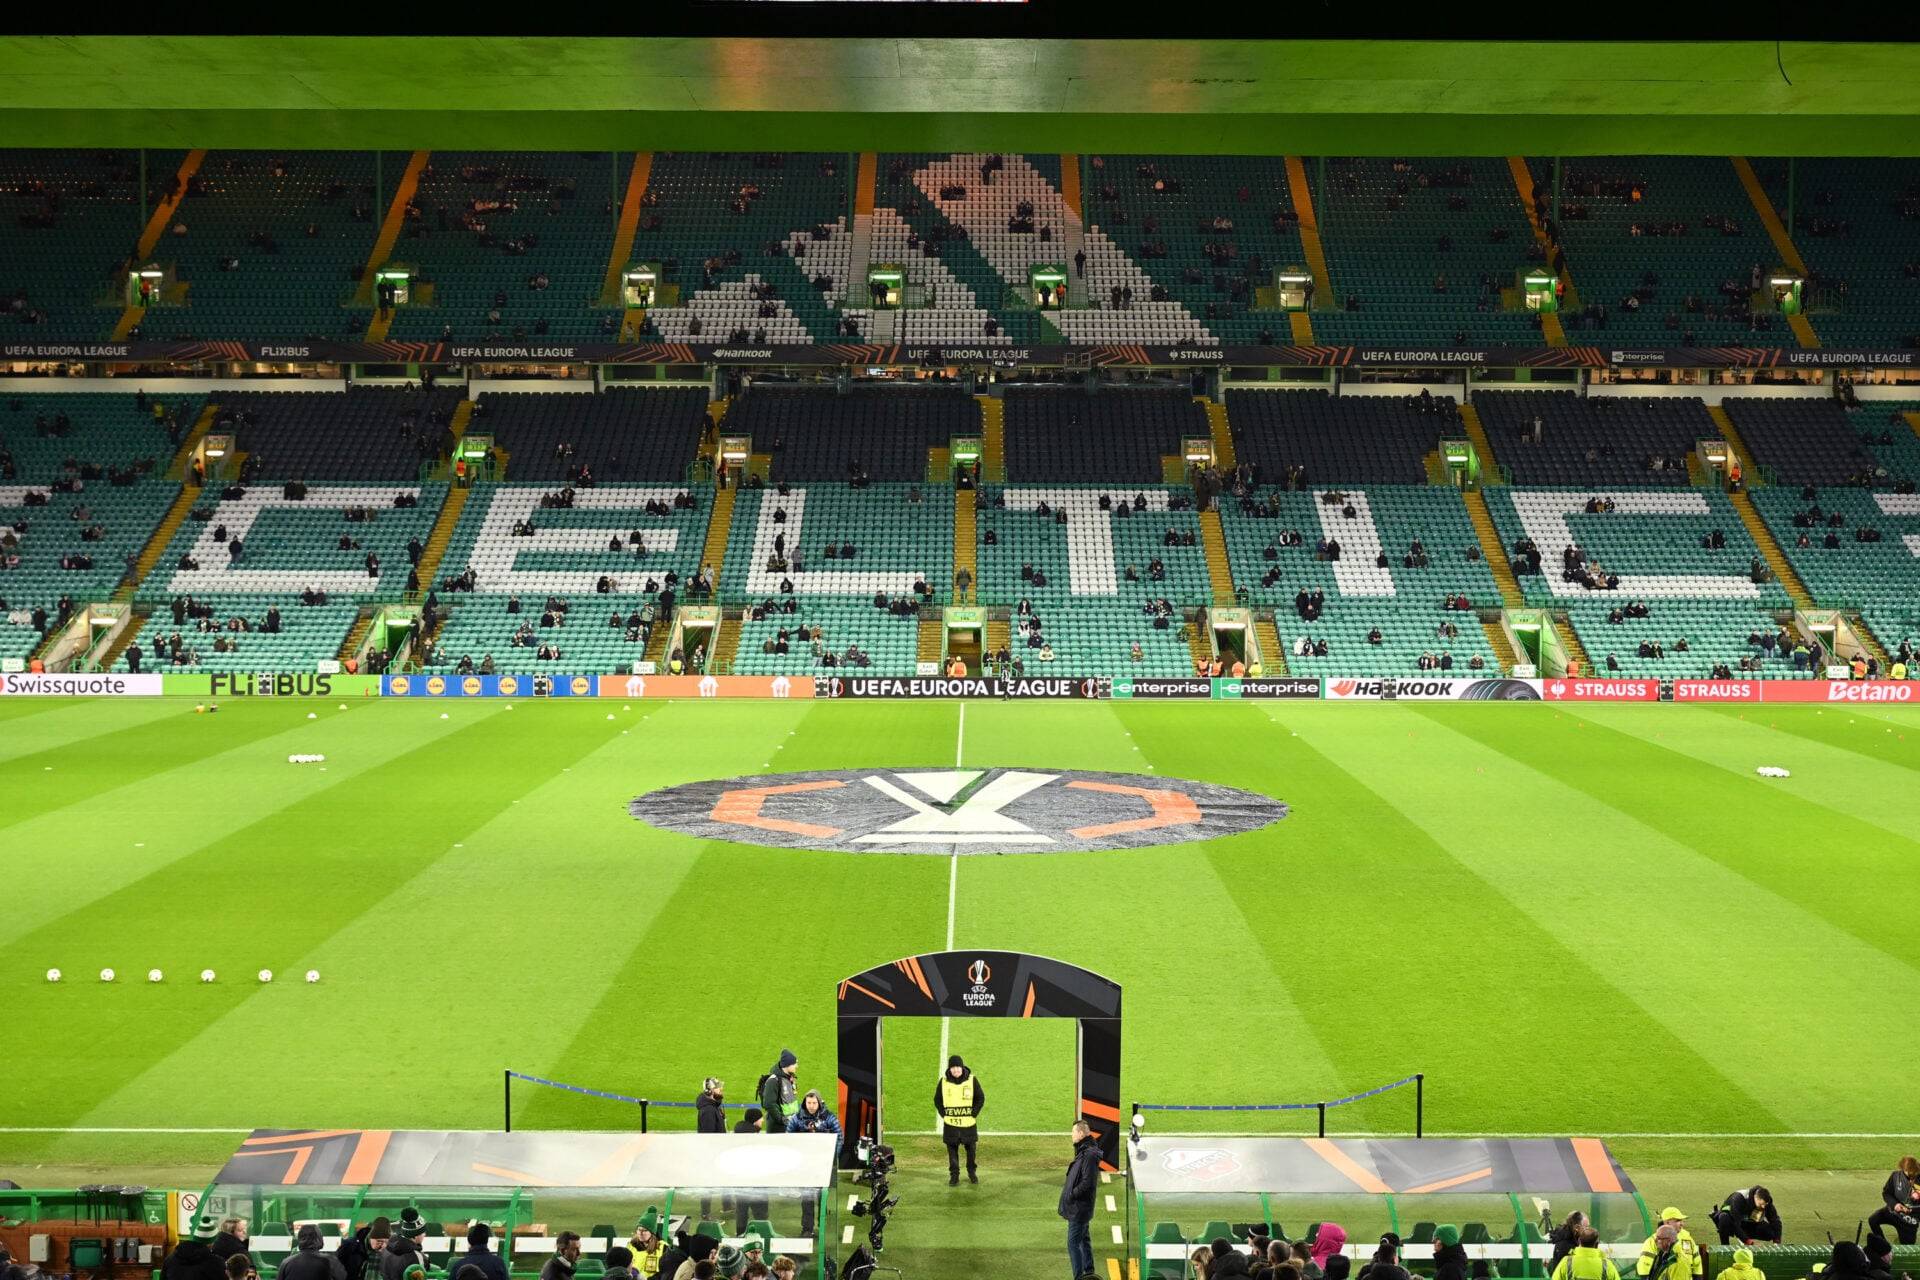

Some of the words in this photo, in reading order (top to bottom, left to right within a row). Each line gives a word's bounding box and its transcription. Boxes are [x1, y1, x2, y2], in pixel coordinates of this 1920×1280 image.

[5, 346, 32, 356] UEFA
[34, 346, 82, 356] EUROPA
[84, 346, 128, 356] LEAGUE
[452, 348, 481, 357] UEFA
[484, 348, 528, 357] EUROPA
[531, 348, 574, 357] LEAGUE
[909, 350, 933, 359] UEF
[941, 350, 983, 359] EUROPA
[986, 350, 1028, 359] LEAGUE
[1180, 351, 1223, 359] STRAUSS
[1362, 352, 1391, 361] UEFA
[1394, 352, 1438, 361] EUROPA
[1441, 352, 1484, 361] LEAGUE
[1614, 352, 1664, 363] enterprise
[1790, 354, 1820, 363] UEFA
[1822, 354, 1866, 363] EUROPA
[1869, 354, 1912, 363] LEAGUE
[7, 675, 125, 696] Swissquote
[211, 675, 331, 695] FLiBUS
[852, 680, 905, 694] UEFA
[910, 681, 991, 695] EUROPA
[993, 681, 1071, 695] LEAGUE
[1117, 682, 1210, 696] enterprise
[1227, 682, 1318, 696] enterprise
[1575, 684, 1646, 697] STRAUSS
[1679, 684, 1751, 697] STRAUSS
[1828, 681, 1911, 700] Betano
[963, 993, 995, 1001] EUROPA
